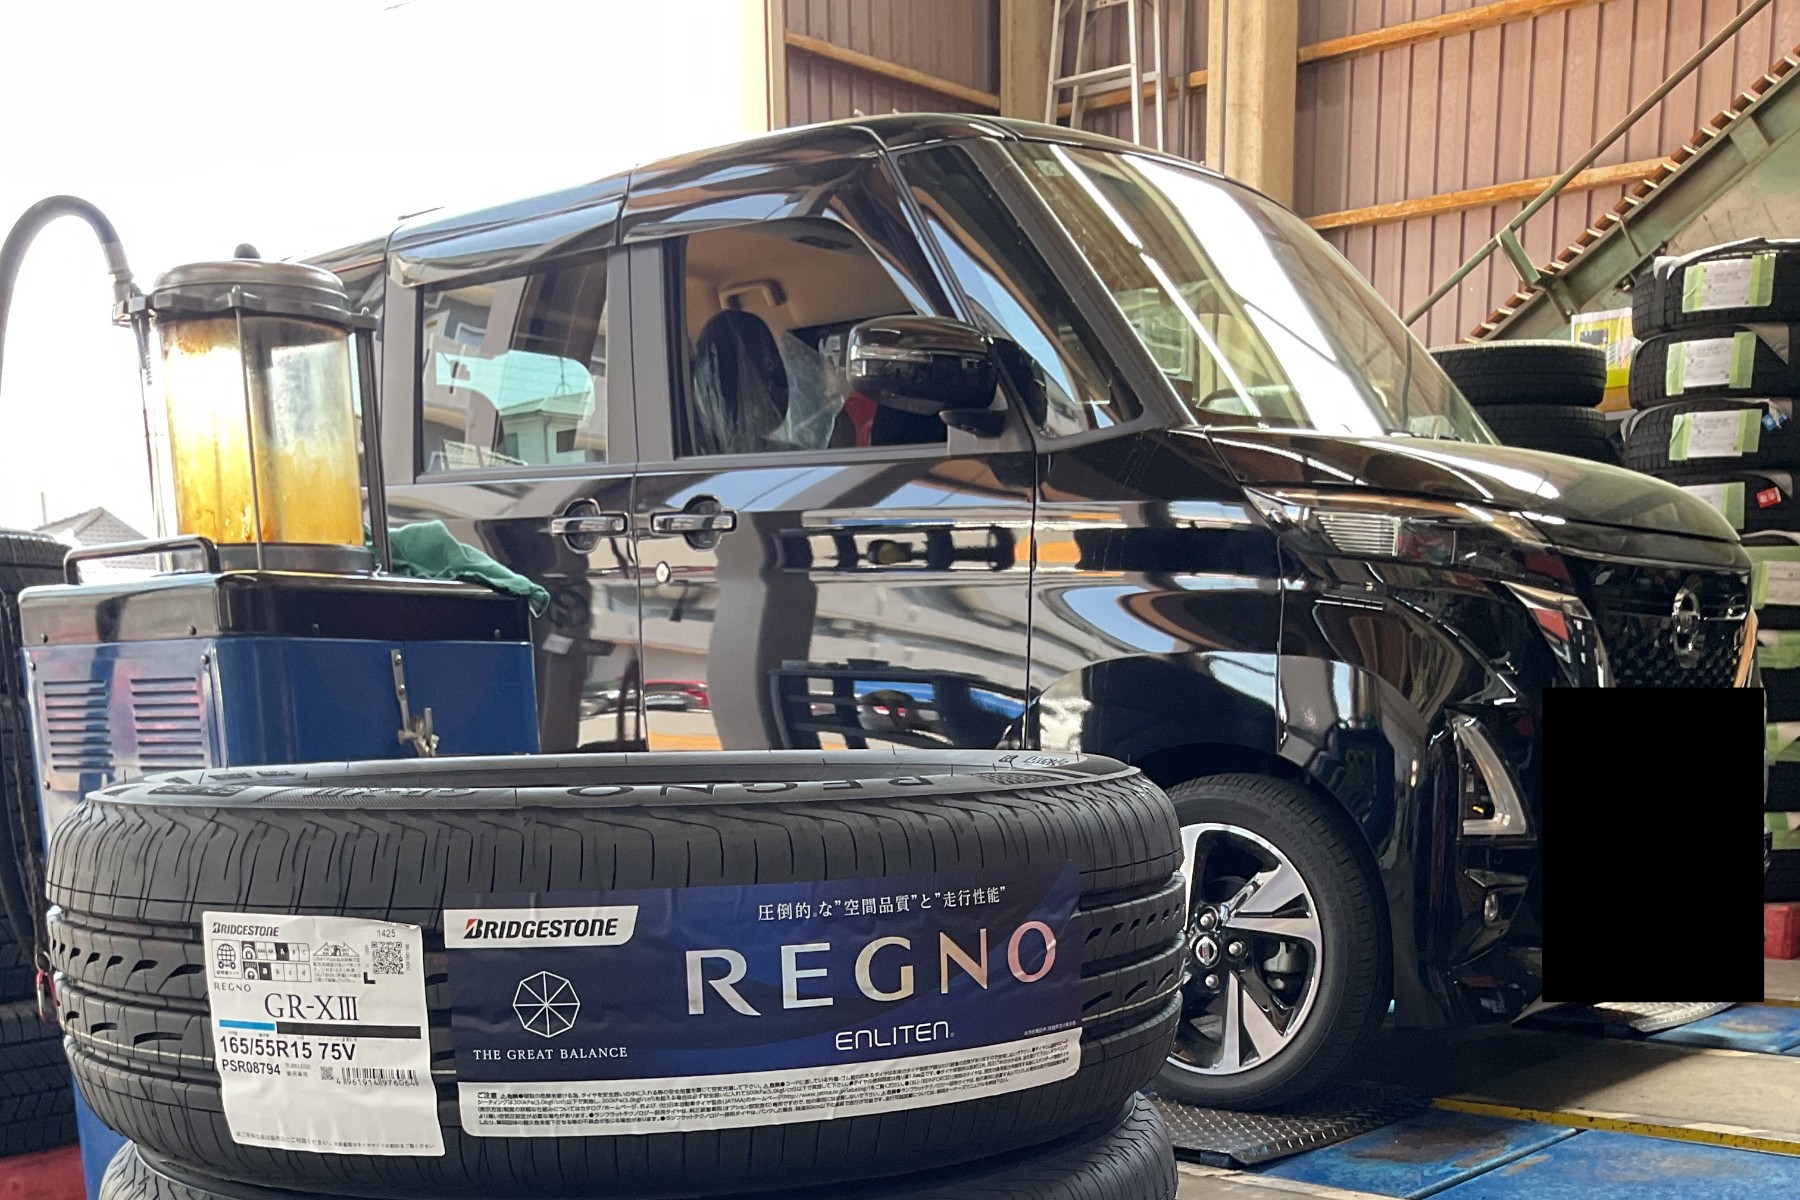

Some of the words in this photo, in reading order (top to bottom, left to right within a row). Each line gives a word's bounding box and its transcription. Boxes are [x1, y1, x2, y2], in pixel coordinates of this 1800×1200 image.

[212, 922, 280, 937] BRIDGESTONE
[377, 929, 396, 938] 1425
[464, 918, 618, 940] BRIDGESTONE
[686, 921, 1057, 1017] REGNO
[214, 982, 252, 992] REGNO
[835, 1021, 950, 1051] ENLITEN
[220, 1036, 312, 1059] 165/55R15
[319, 1042, 356, 1061] 75V
[473, 1049, 501, 1061] THE
[507, 1049, 554, 1061] GREAT
[561, 1047, 628, 1060] BALANCE
[222, 1059, 281, 1076] PSR08794
